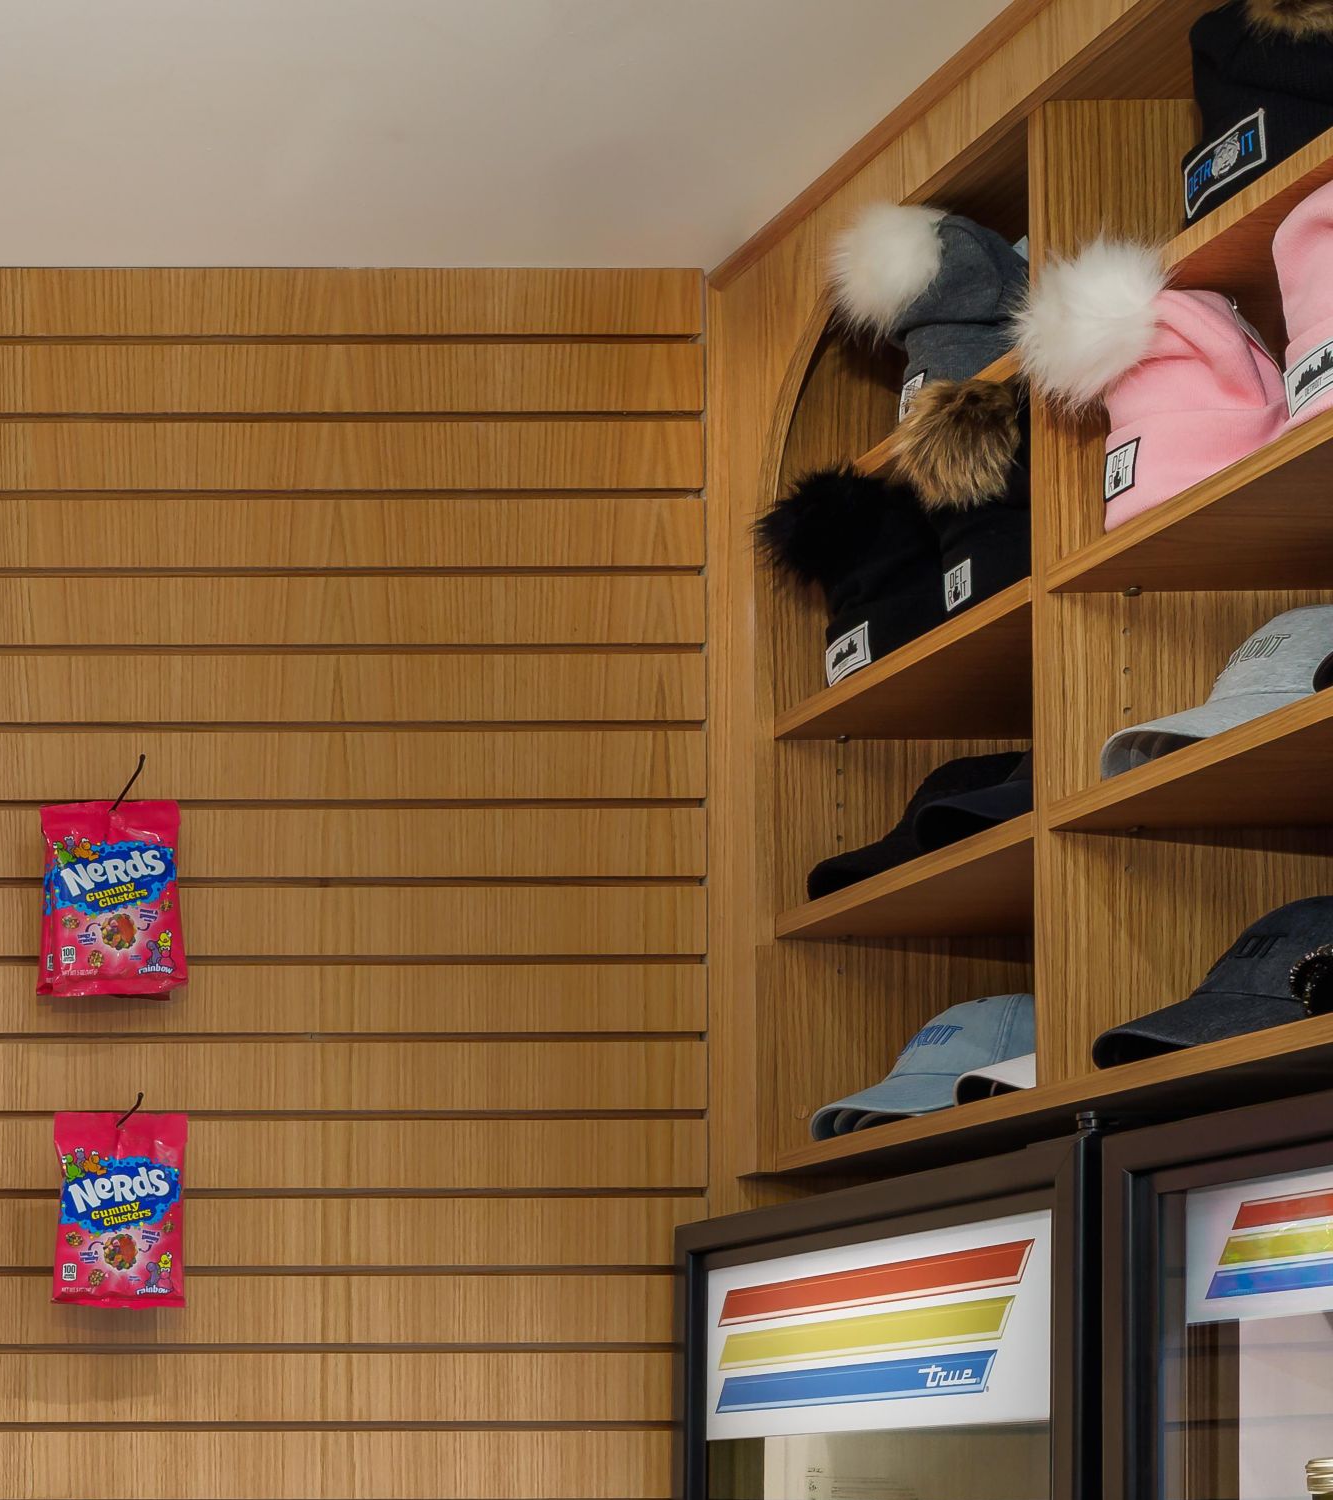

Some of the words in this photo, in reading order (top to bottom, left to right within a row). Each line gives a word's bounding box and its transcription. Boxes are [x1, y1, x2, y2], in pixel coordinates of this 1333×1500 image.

[85, 882, 136, 903] Gummy
[98, 888, 148, 909] Clusters
[90, 1201, 141, 1222] Gummy
[103, 1207, 153, 1228] Clusters
